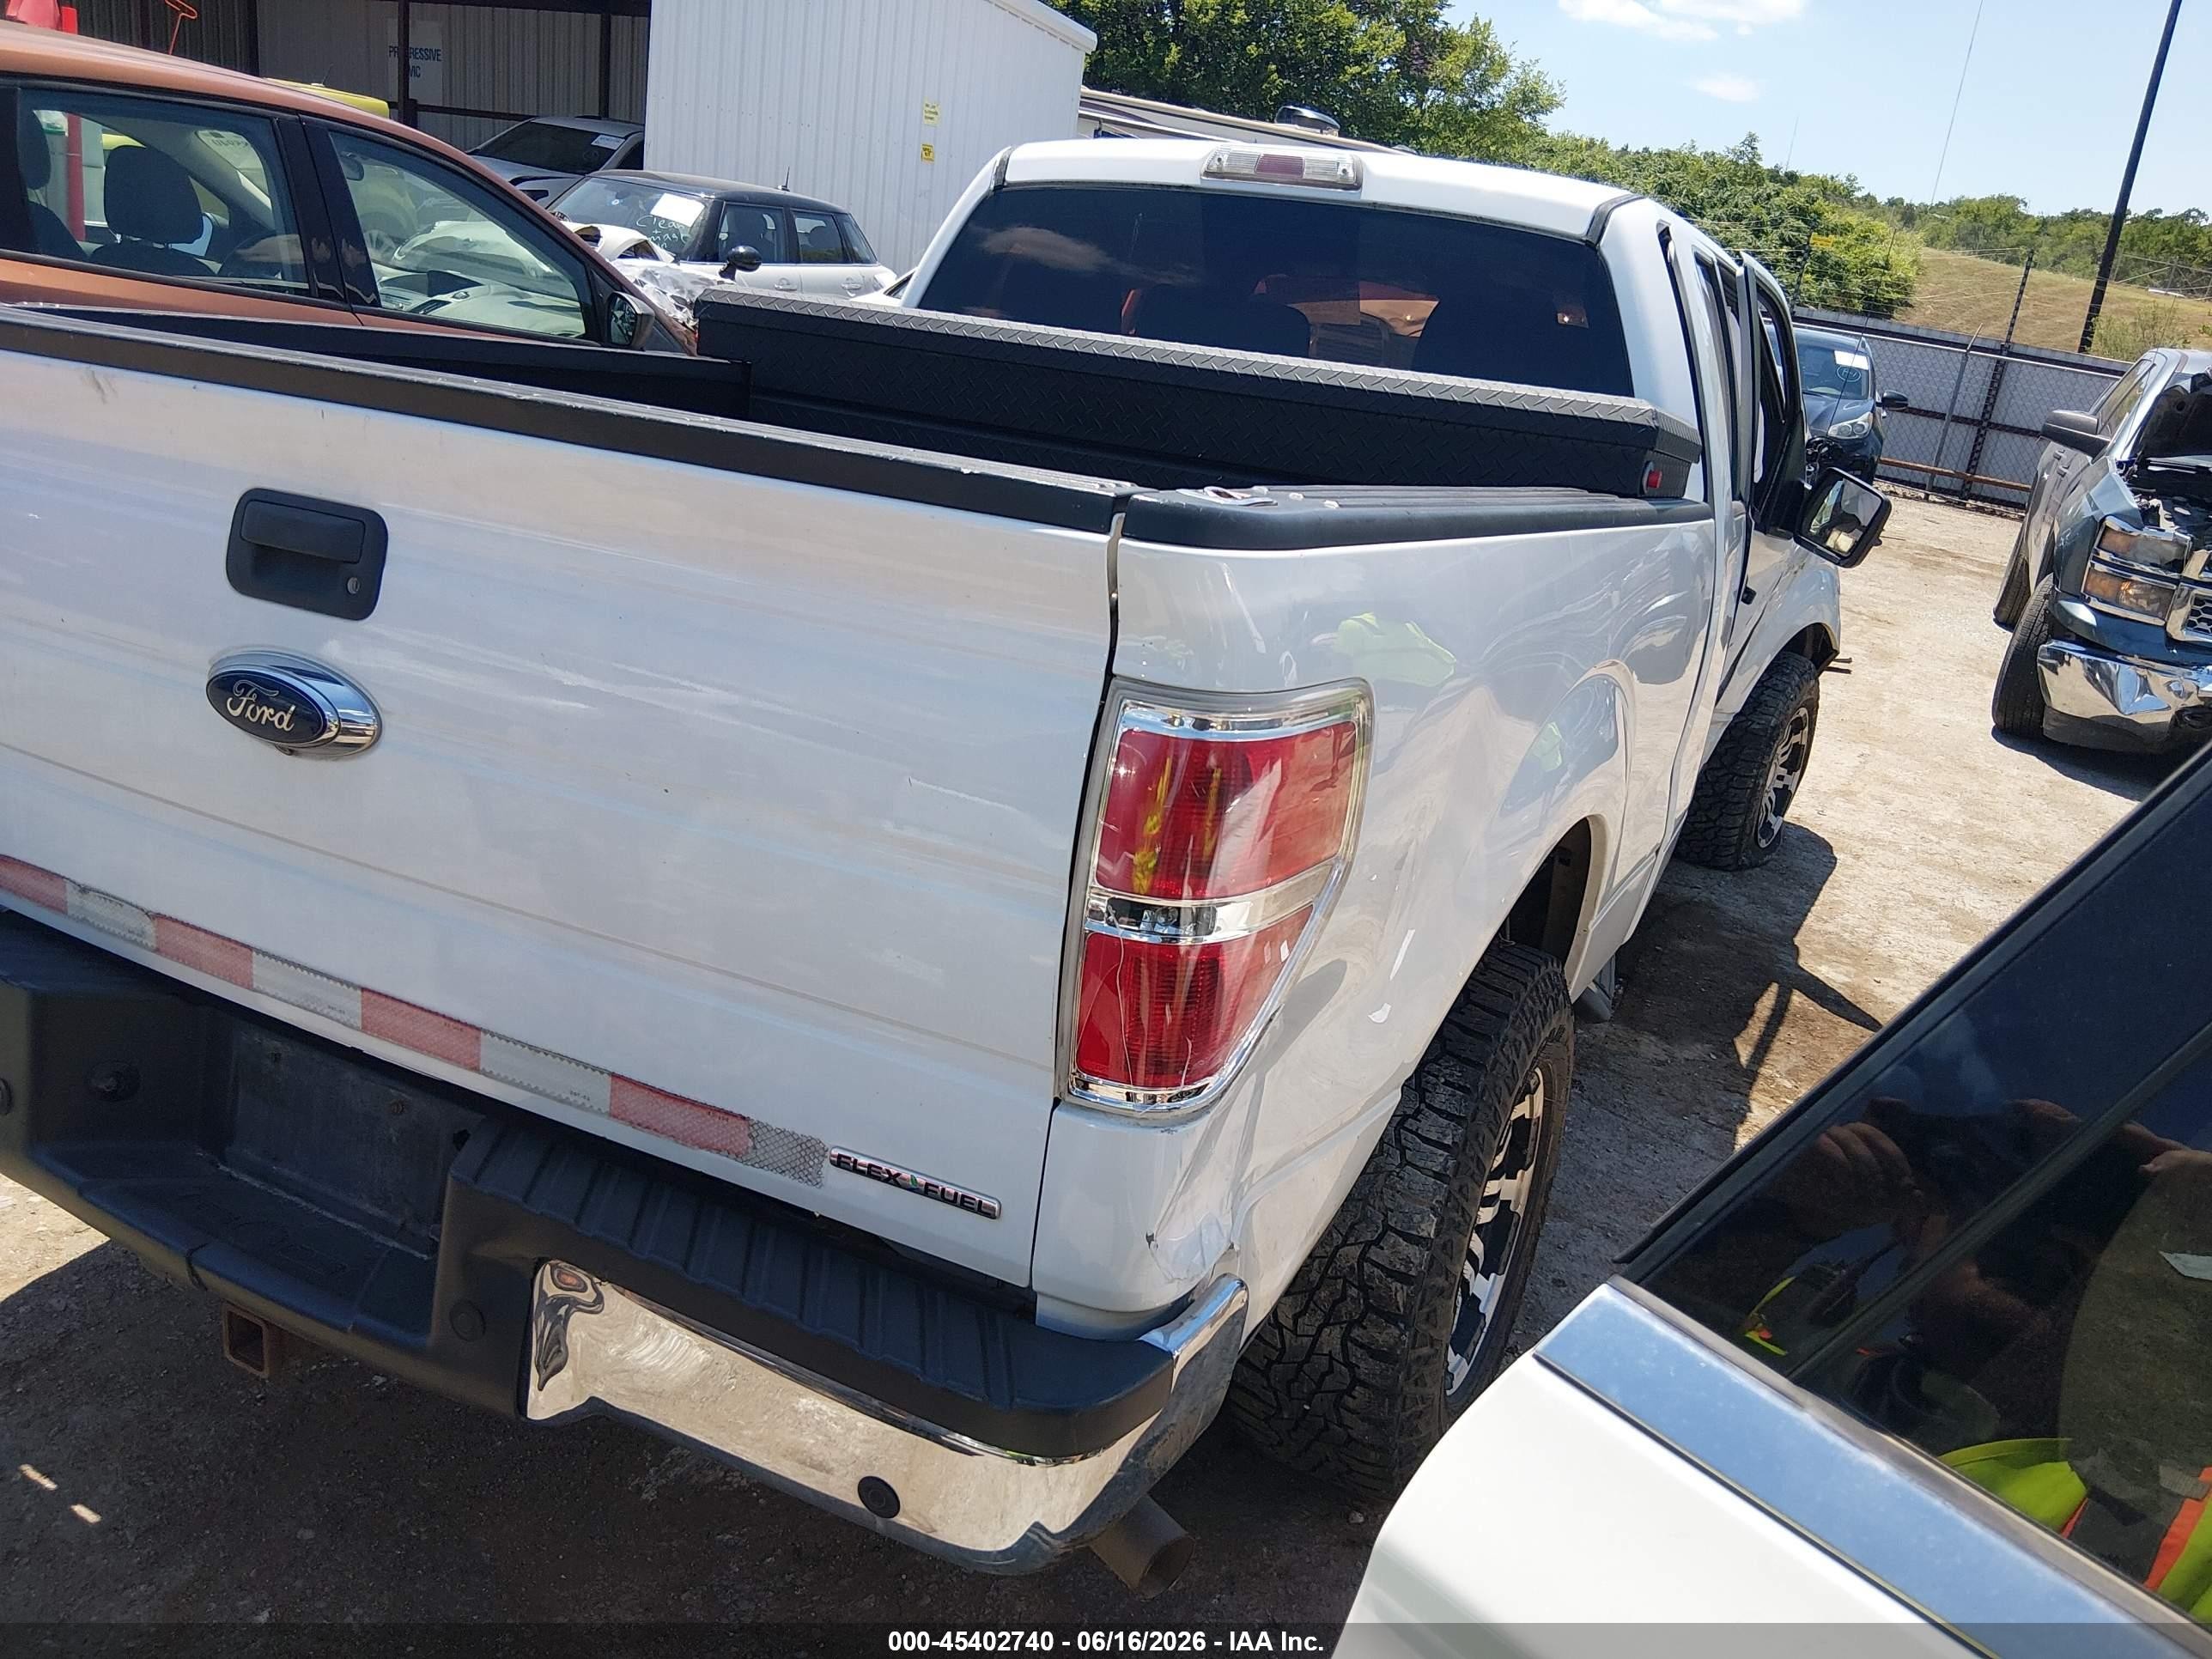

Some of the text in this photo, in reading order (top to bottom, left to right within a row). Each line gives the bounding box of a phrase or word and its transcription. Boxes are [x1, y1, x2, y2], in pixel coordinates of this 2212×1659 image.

[226, 679, 296, 732] Ford
[836, 1152, 997, 1218] FLEX FUEL
